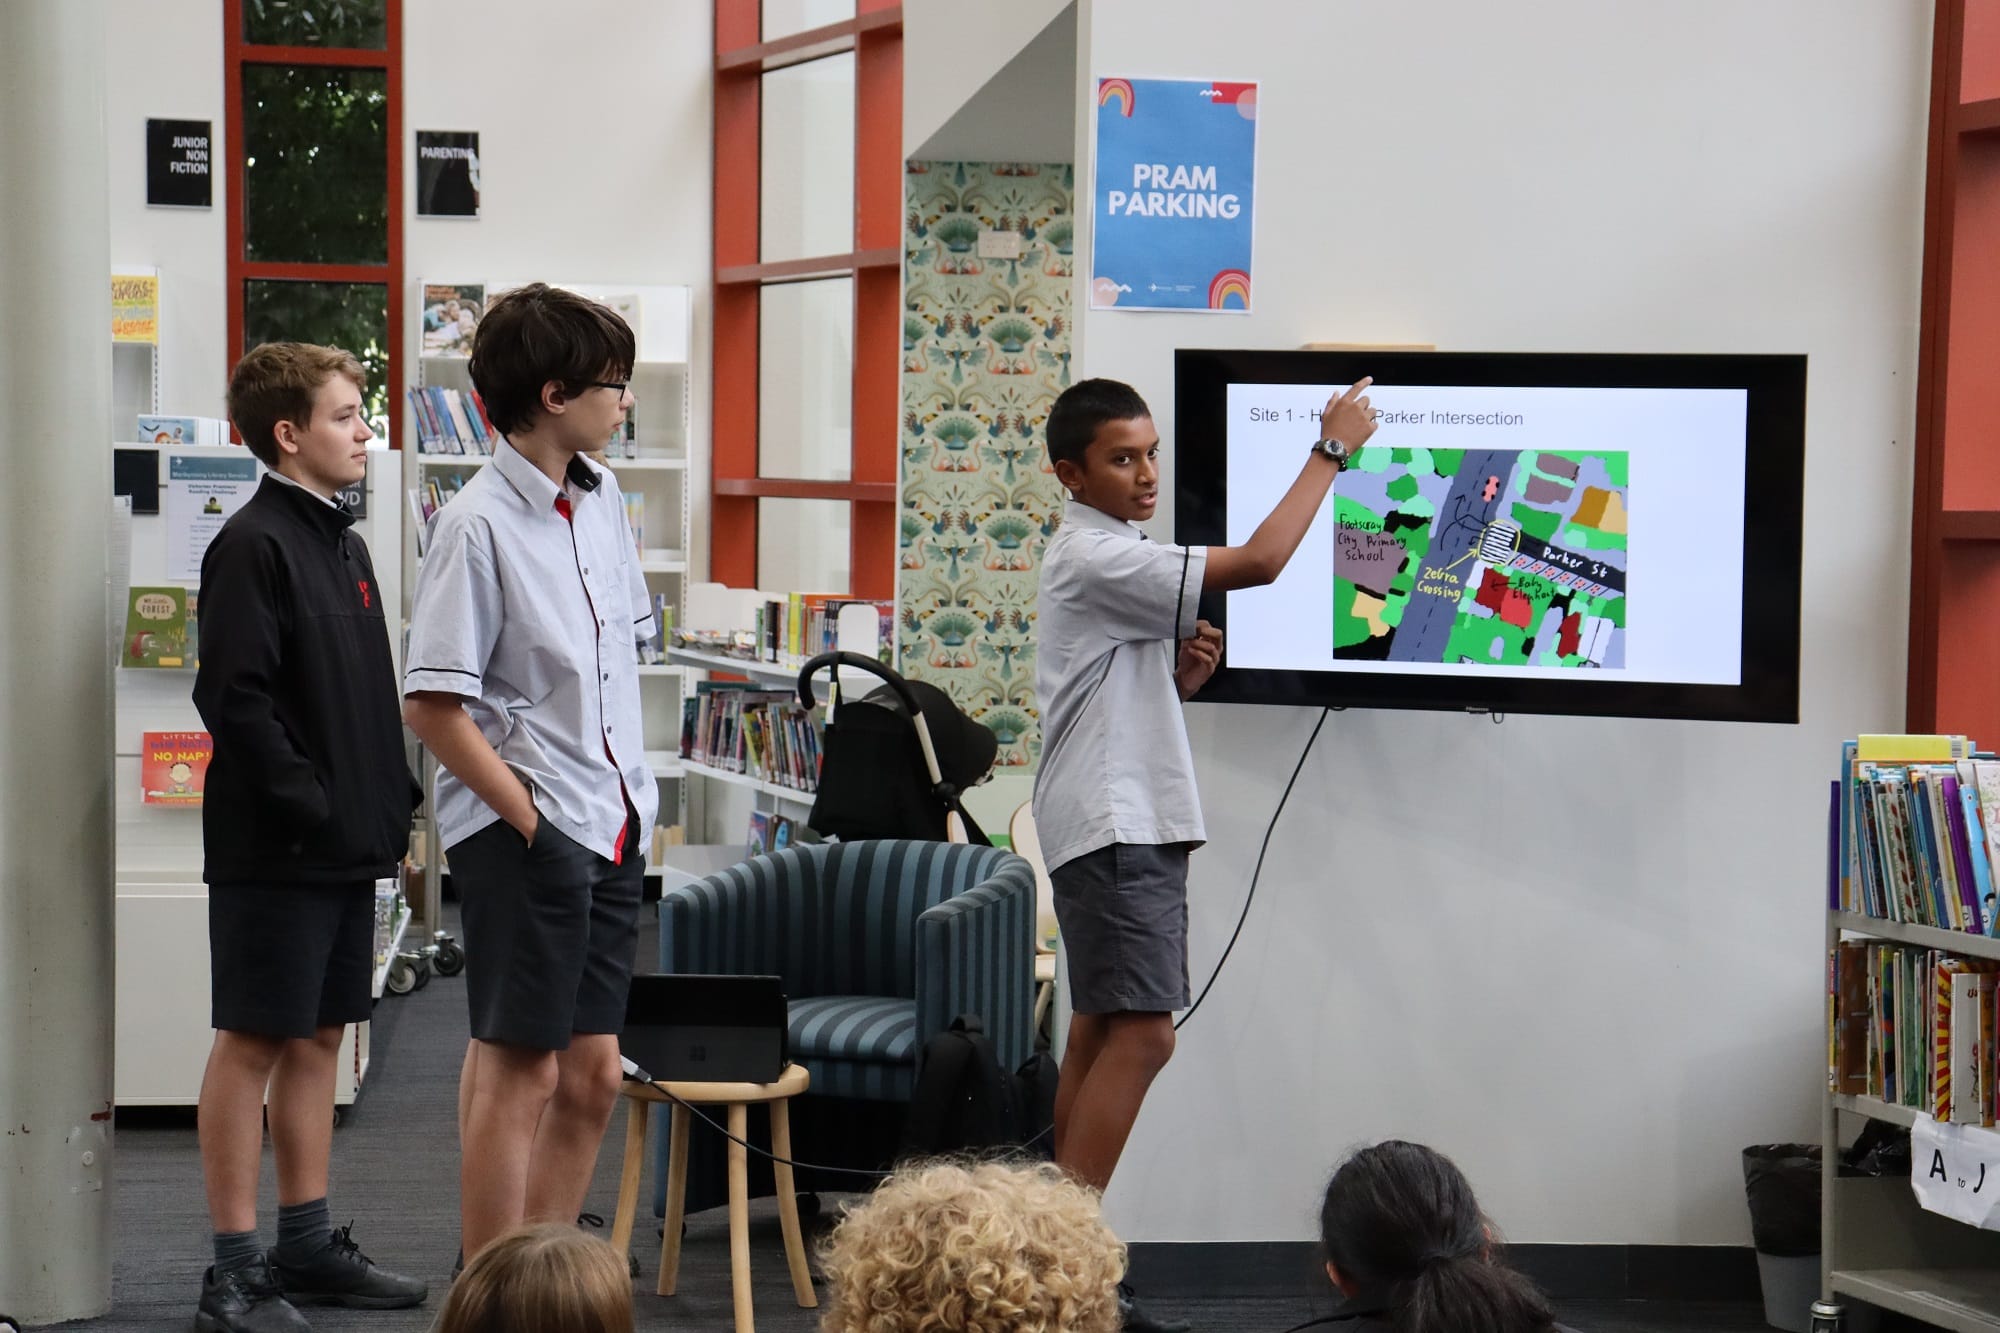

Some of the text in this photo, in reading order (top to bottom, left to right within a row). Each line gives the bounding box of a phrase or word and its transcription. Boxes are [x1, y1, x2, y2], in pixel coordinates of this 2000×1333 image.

[172, 136, 208, 148] JUNIOR
[186, 150, 208, 161] NON
[170, 161, 208, 174] FICTION
[1133, 163, 1217, 191] PRAM
[1108, 190, 1241, 219] PARKING
[1250, 407, 1279, 422] Site
[1286, 408, 1292, 421] 1
[1374, 410, 1425, 424] Parker
[1431, 410, 1524, 425] Intersection
[340, 491, 361, 506] VD
[1340, 513, 1382, 535] Footscray
[1338, 532, 1406, 550] City Primary
[1345, 548, 1385, 561] School
[1542, 546, 1608, 578] Parker St
[1423, 566, 1459, 584] Zebra
[1417, 580, 1461, 603] Crossing
[153, 751, 210, 762] NO NAP!
[1929, 1148, 1986, 1194] A to J
